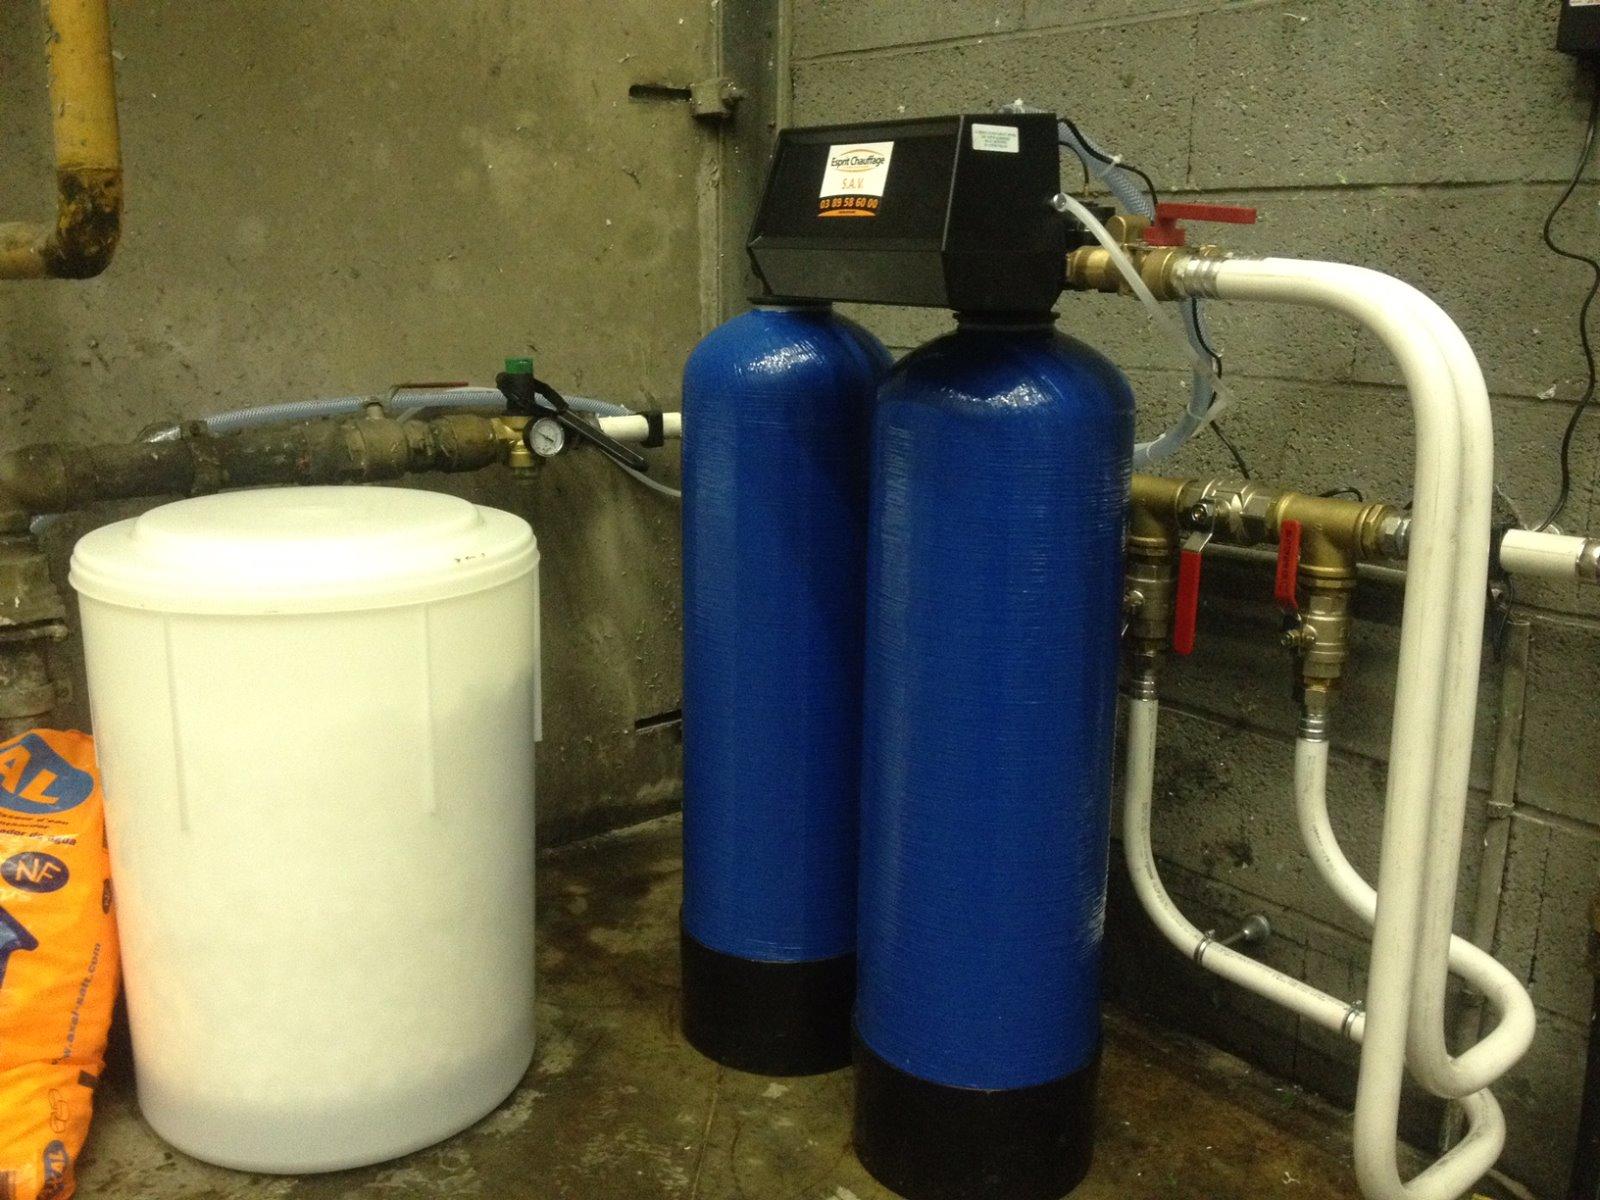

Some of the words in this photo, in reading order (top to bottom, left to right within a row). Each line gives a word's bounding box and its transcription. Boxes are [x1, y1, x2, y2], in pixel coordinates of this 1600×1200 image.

[831, 157, 850, 168] Esprit
[850, 155, 886, 167] Chauffage
[820, 199, 830, 209] 03
[843, 197, 854, 207] 58
[855, 197, 867, 208] 60
[867, 198, 879, 209] 00
[15, 858, 61, 883] NF
